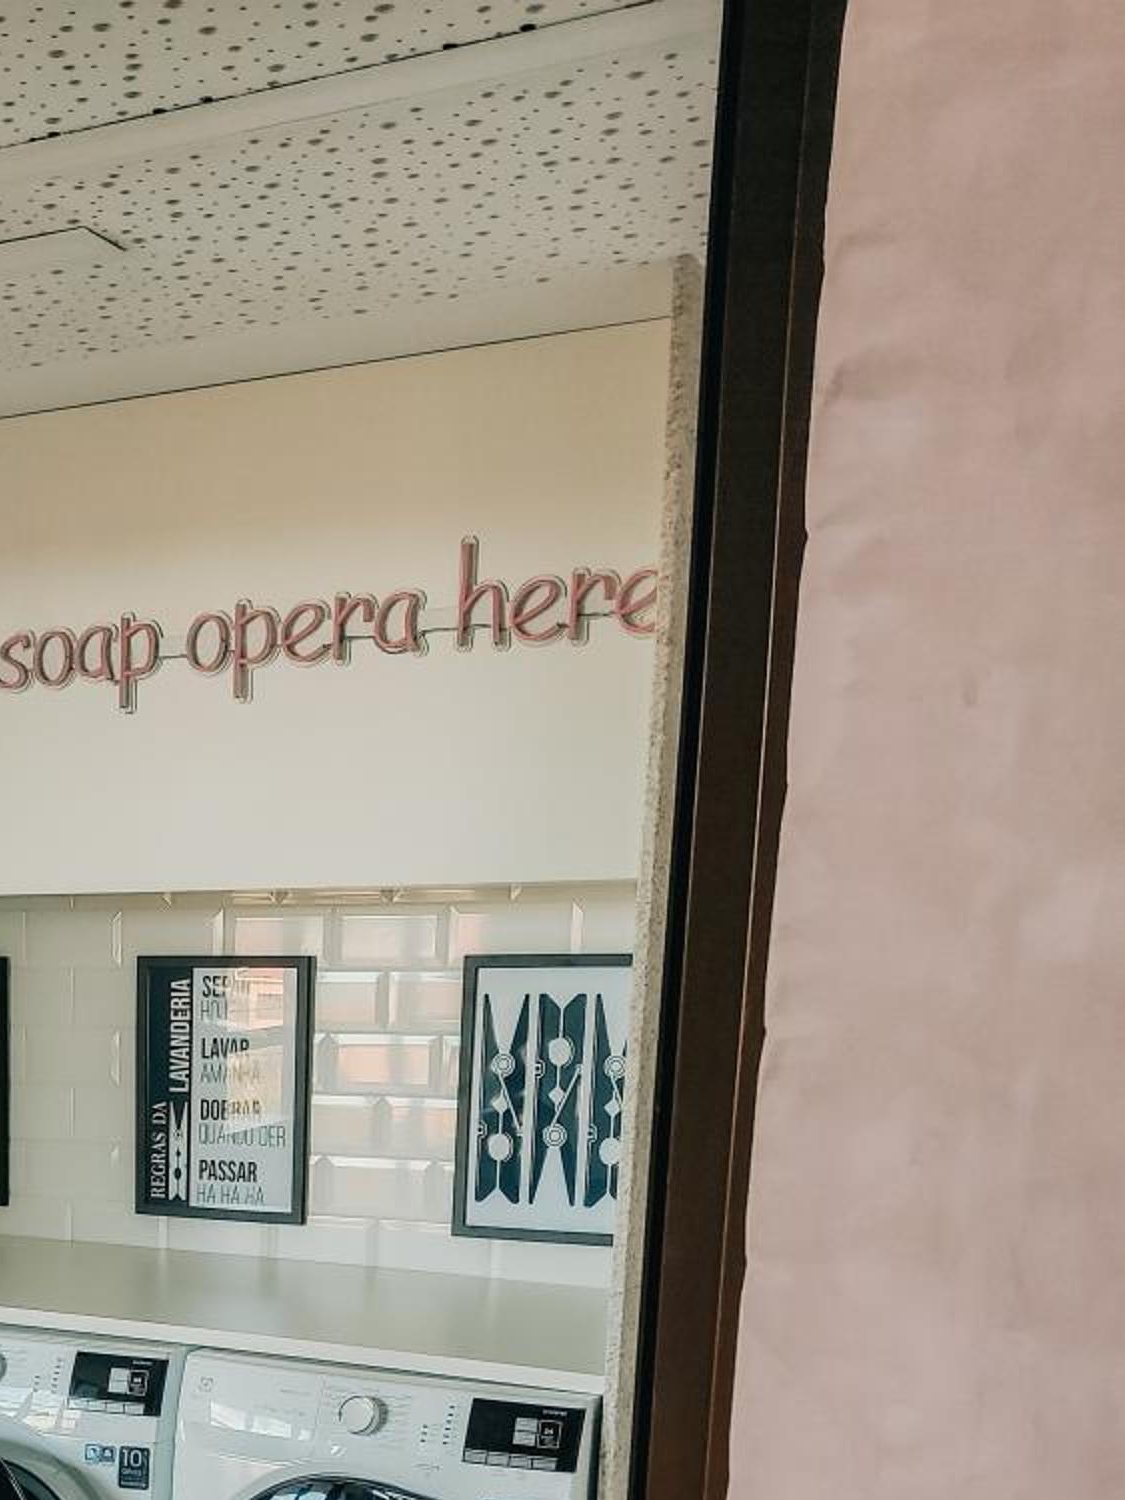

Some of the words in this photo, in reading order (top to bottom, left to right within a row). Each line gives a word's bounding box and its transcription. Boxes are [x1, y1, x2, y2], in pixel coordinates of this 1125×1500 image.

[185, 590, 428, 704] opera
[455, 534, 659, 653] here
[169, 978, 192, 1093] LAVANDERIA
[201, 1037, 251, 1060] LAVAR
[151, 1102, 168, 1125] DA
[150, 1131, 168, 1199] REGRAS
[198, 1159, 258, 1183] PASSAR
[122, 1449, 142, 1468] 10
